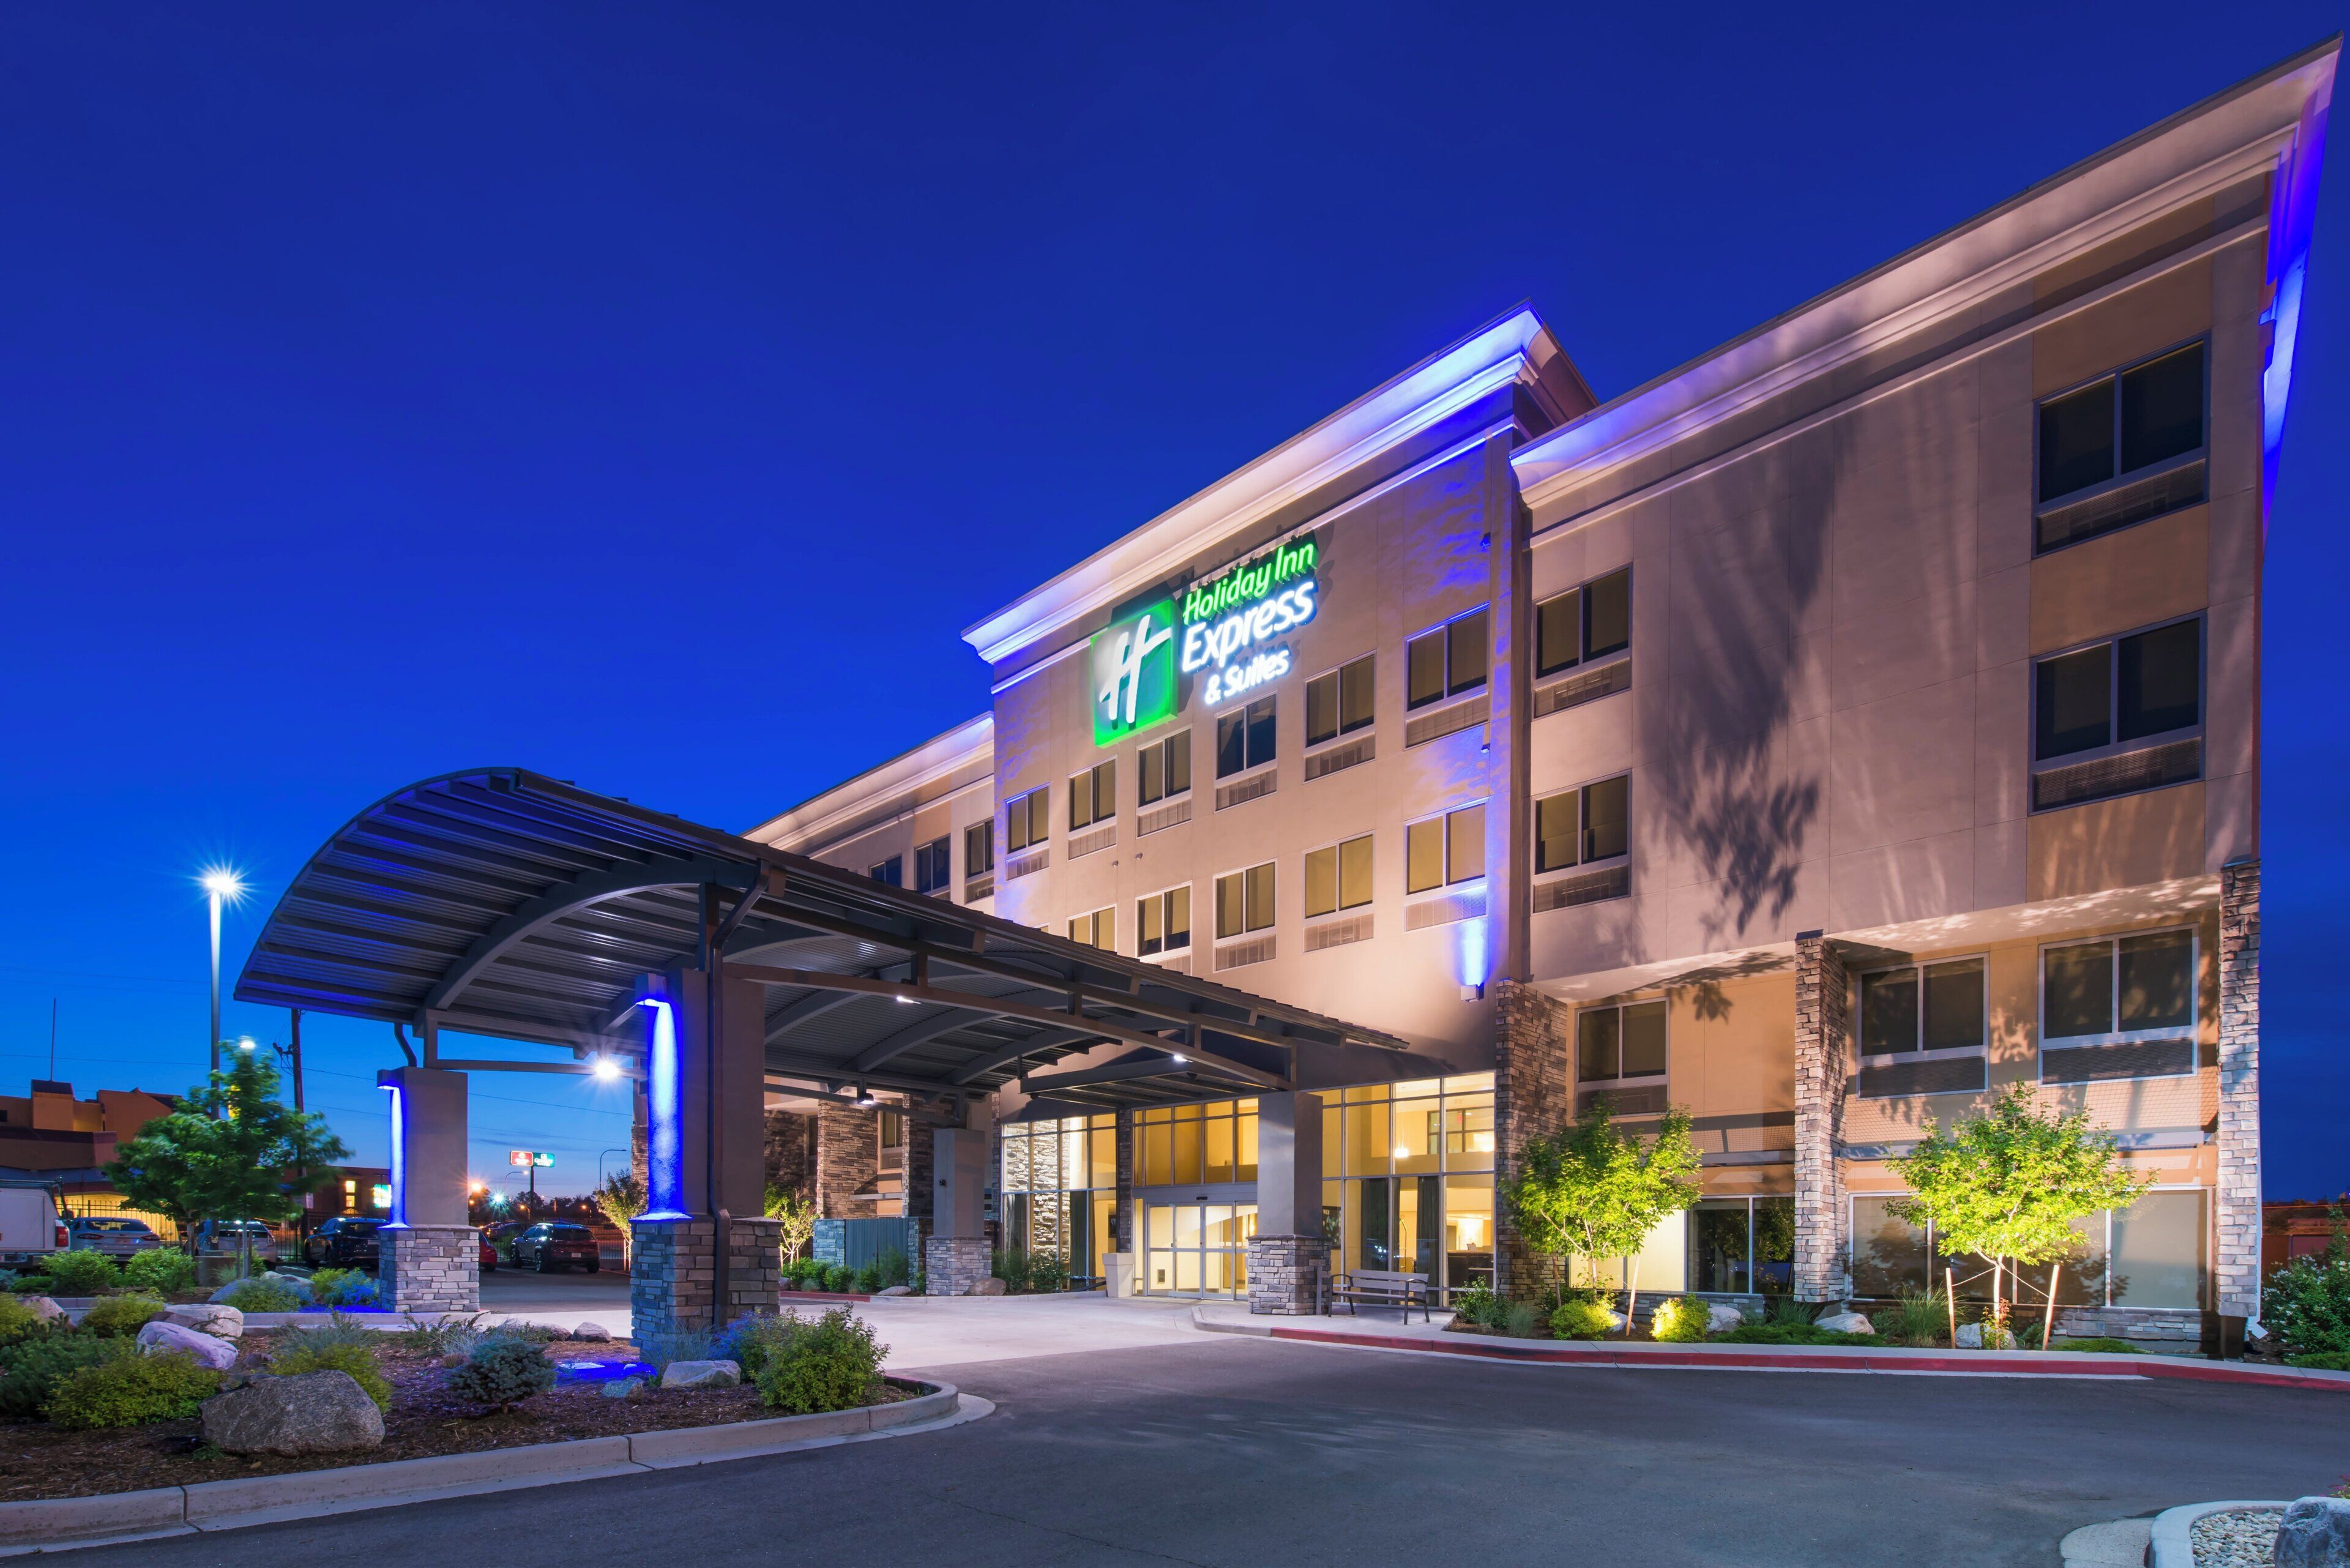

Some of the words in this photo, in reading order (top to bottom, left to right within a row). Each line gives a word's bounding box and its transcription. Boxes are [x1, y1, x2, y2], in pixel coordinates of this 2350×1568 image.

[1182, 562, 1272, 625] Holiday
[1274, 543, 1315, 581] Inn
[1182, 581, 1314, 673] Express
[1204, 674, 1222, 704] &
[1223, 649, 1289, 697] Suites
